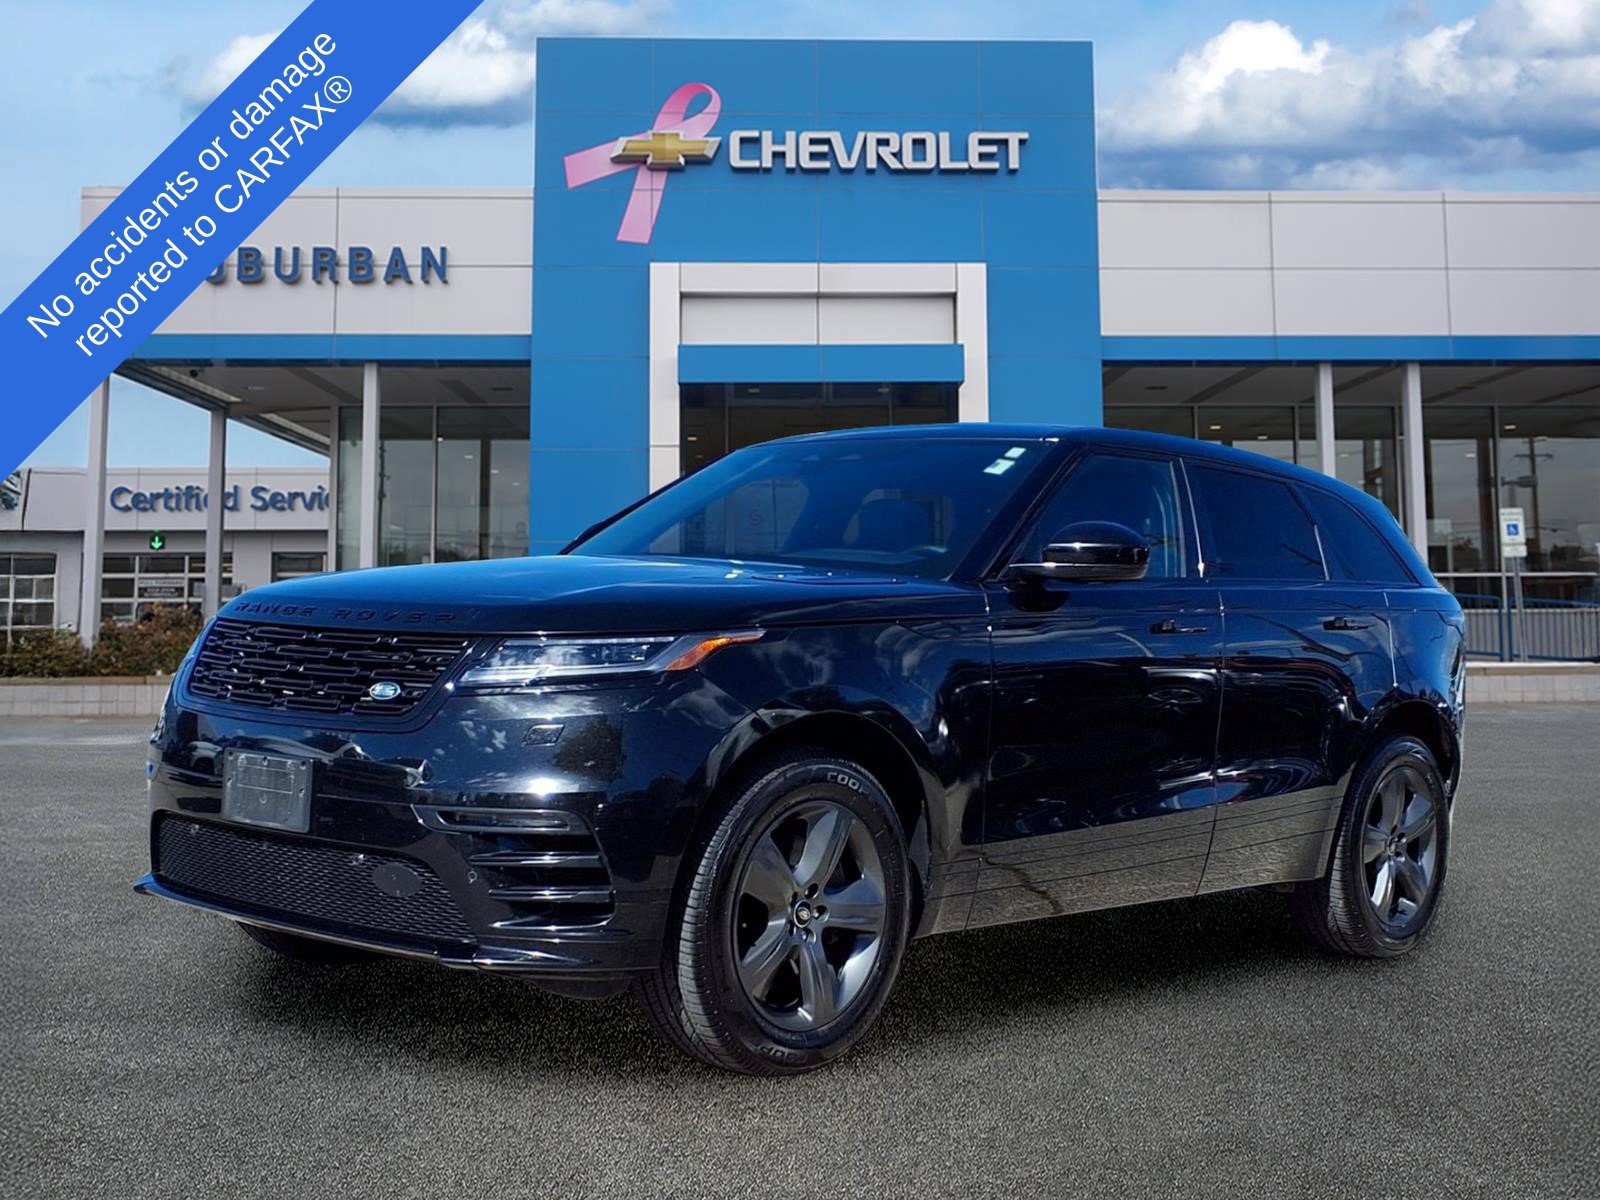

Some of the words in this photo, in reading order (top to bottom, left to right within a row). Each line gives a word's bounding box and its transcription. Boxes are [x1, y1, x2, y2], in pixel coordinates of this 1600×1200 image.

[729, 130, 1029, 171] CHEVROLET
[110, 484, 240, 512] Certifid
[250, 485, 330, 512] Servi
[234, 602, 317, 617] RANGE
[332, 608, 457, 625] ROVER
